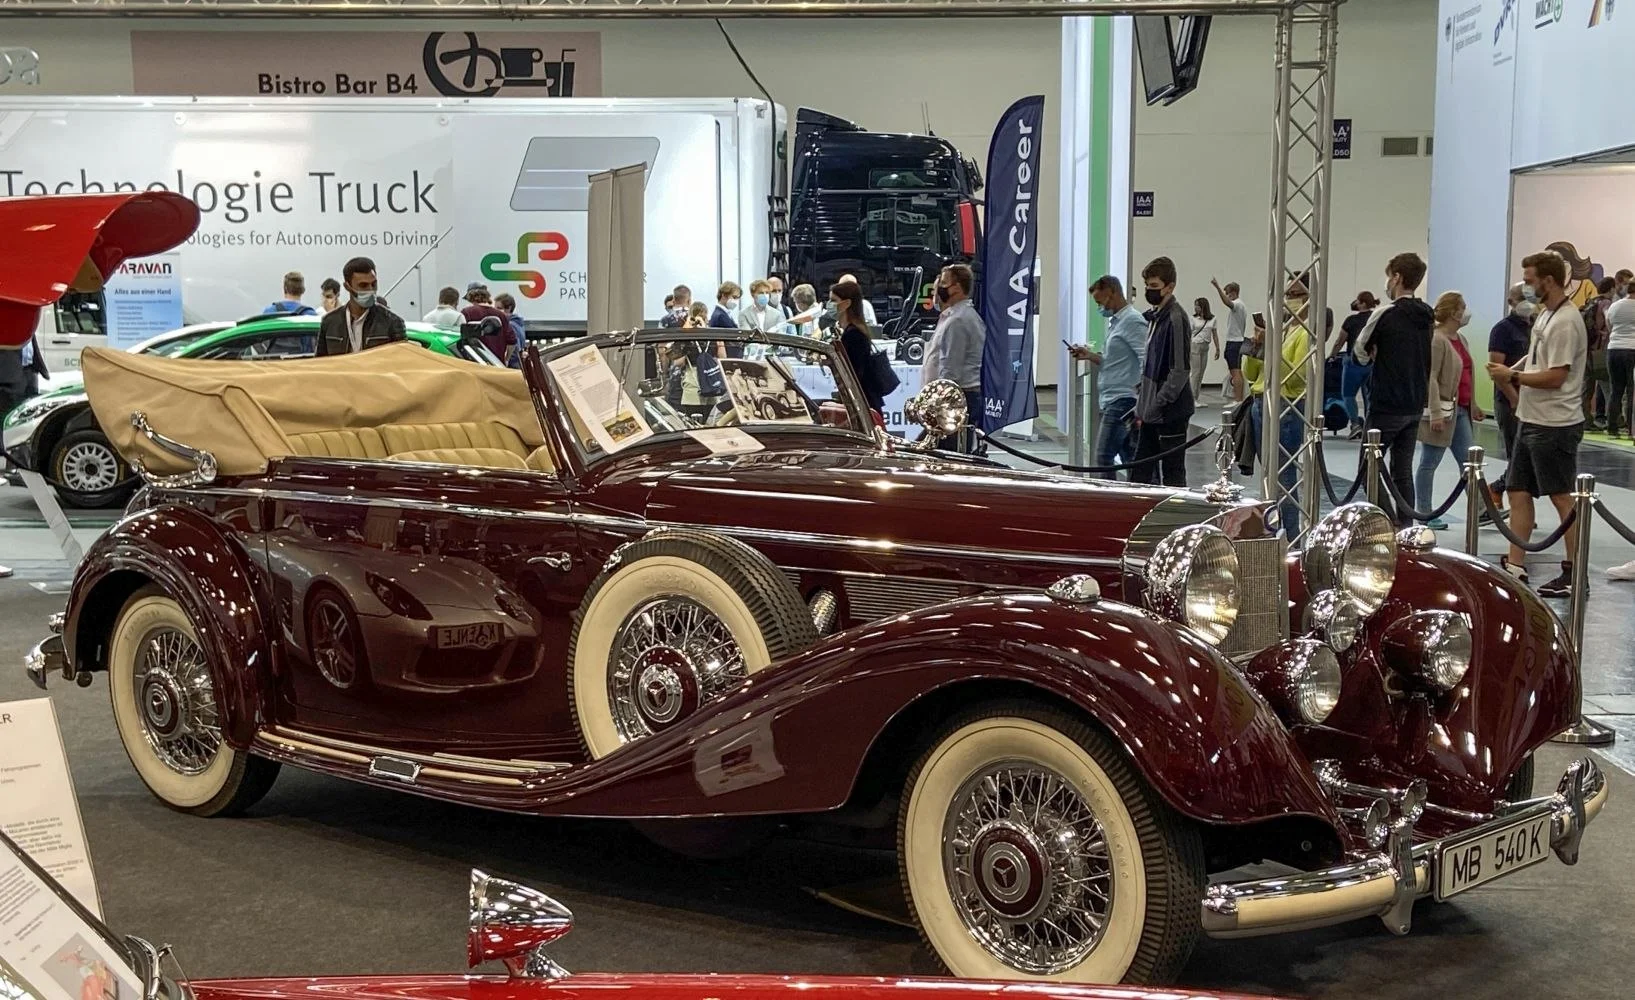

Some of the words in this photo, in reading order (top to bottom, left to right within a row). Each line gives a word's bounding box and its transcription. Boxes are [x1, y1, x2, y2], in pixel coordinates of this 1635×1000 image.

[258, 73, 326, 94] Bistro
[336, 73, 378, 94] Bar
[386, 73, 418, 94] B4
[309, 170, 438, 214] Truck
[1008, 119, 1033, 256] Career
[250, 230, 271, 245] for
[275, 231, 378, 246] Autonomous
[383, 231, 439, 249] Driving
[1007, 266, 1030, 336] IAA
[1452, 845, 1482, 889] MB
